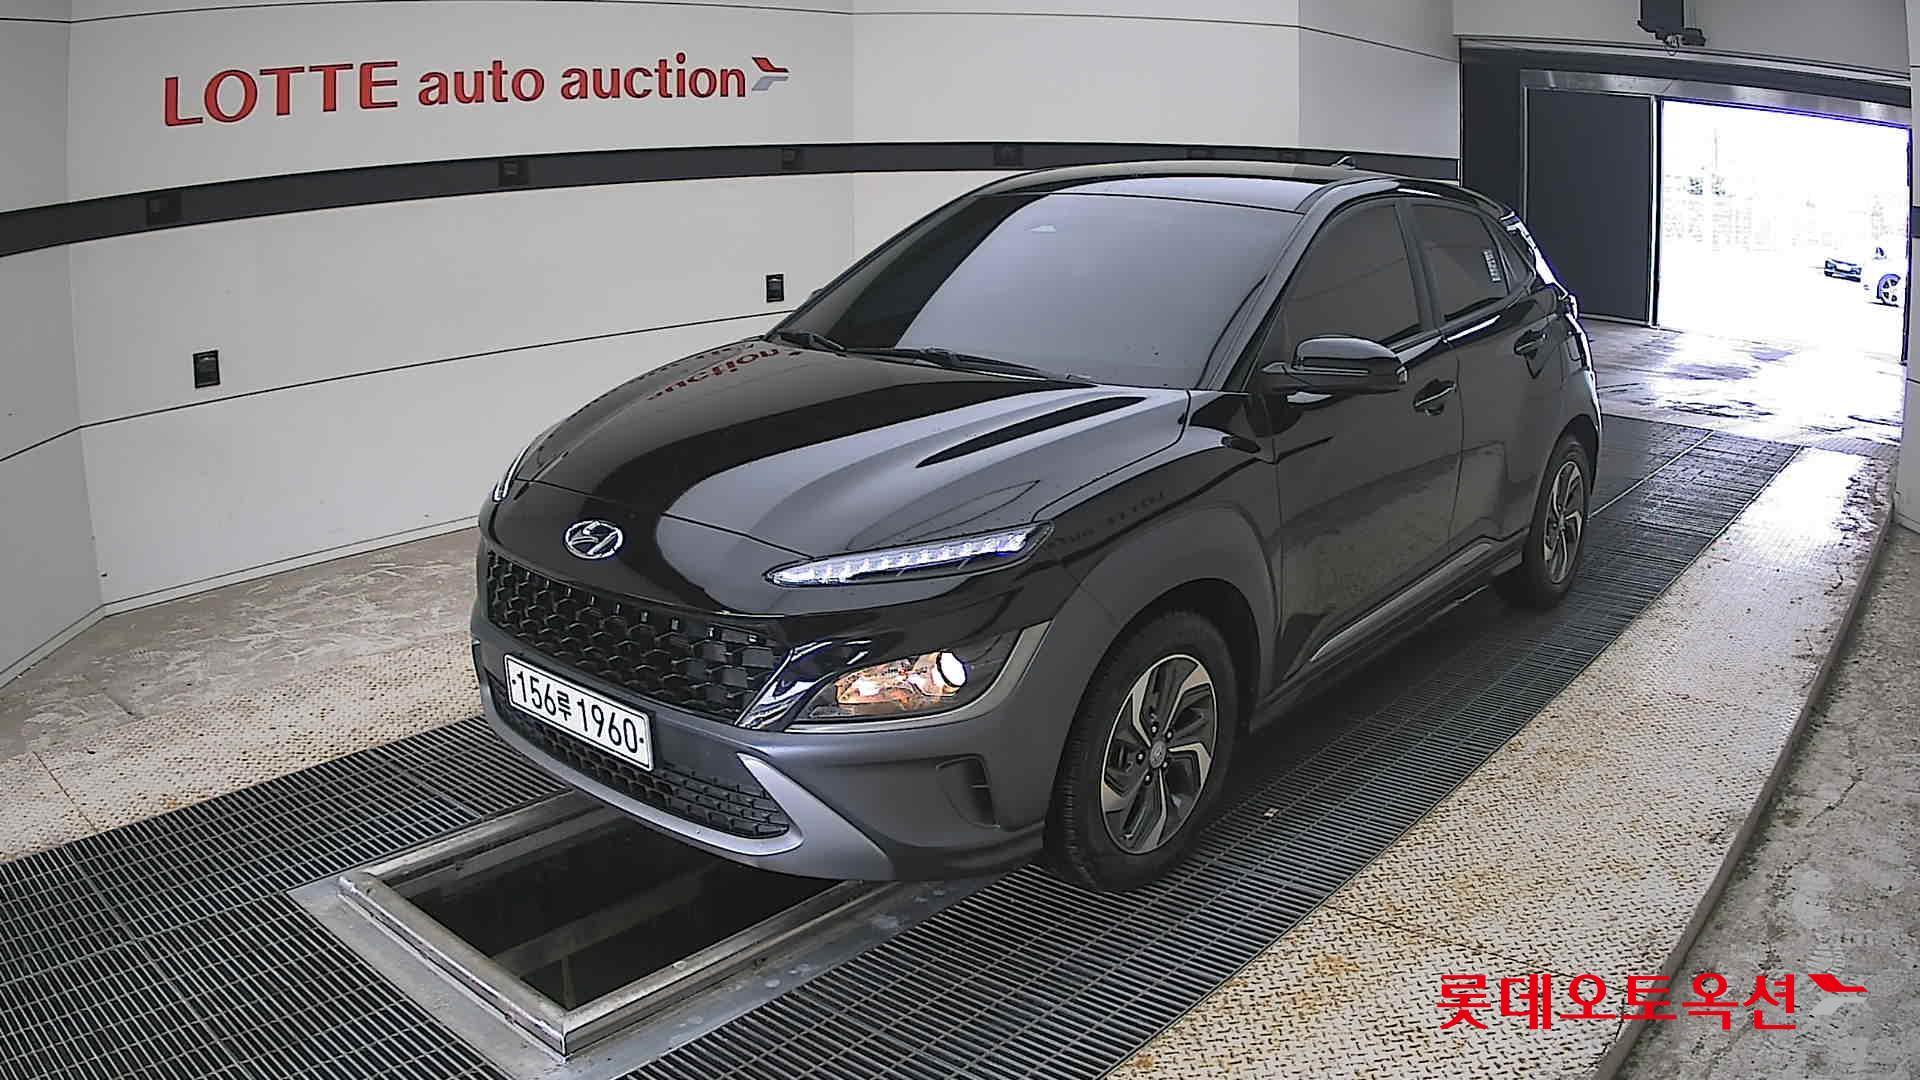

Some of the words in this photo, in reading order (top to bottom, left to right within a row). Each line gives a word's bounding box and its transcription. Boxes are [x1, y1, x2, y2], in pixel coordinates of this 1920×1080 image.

[164, 61, 398, 127] LOTTE
[417, 60, 545, 106] auto
[560, 52, 747, 100] auction
